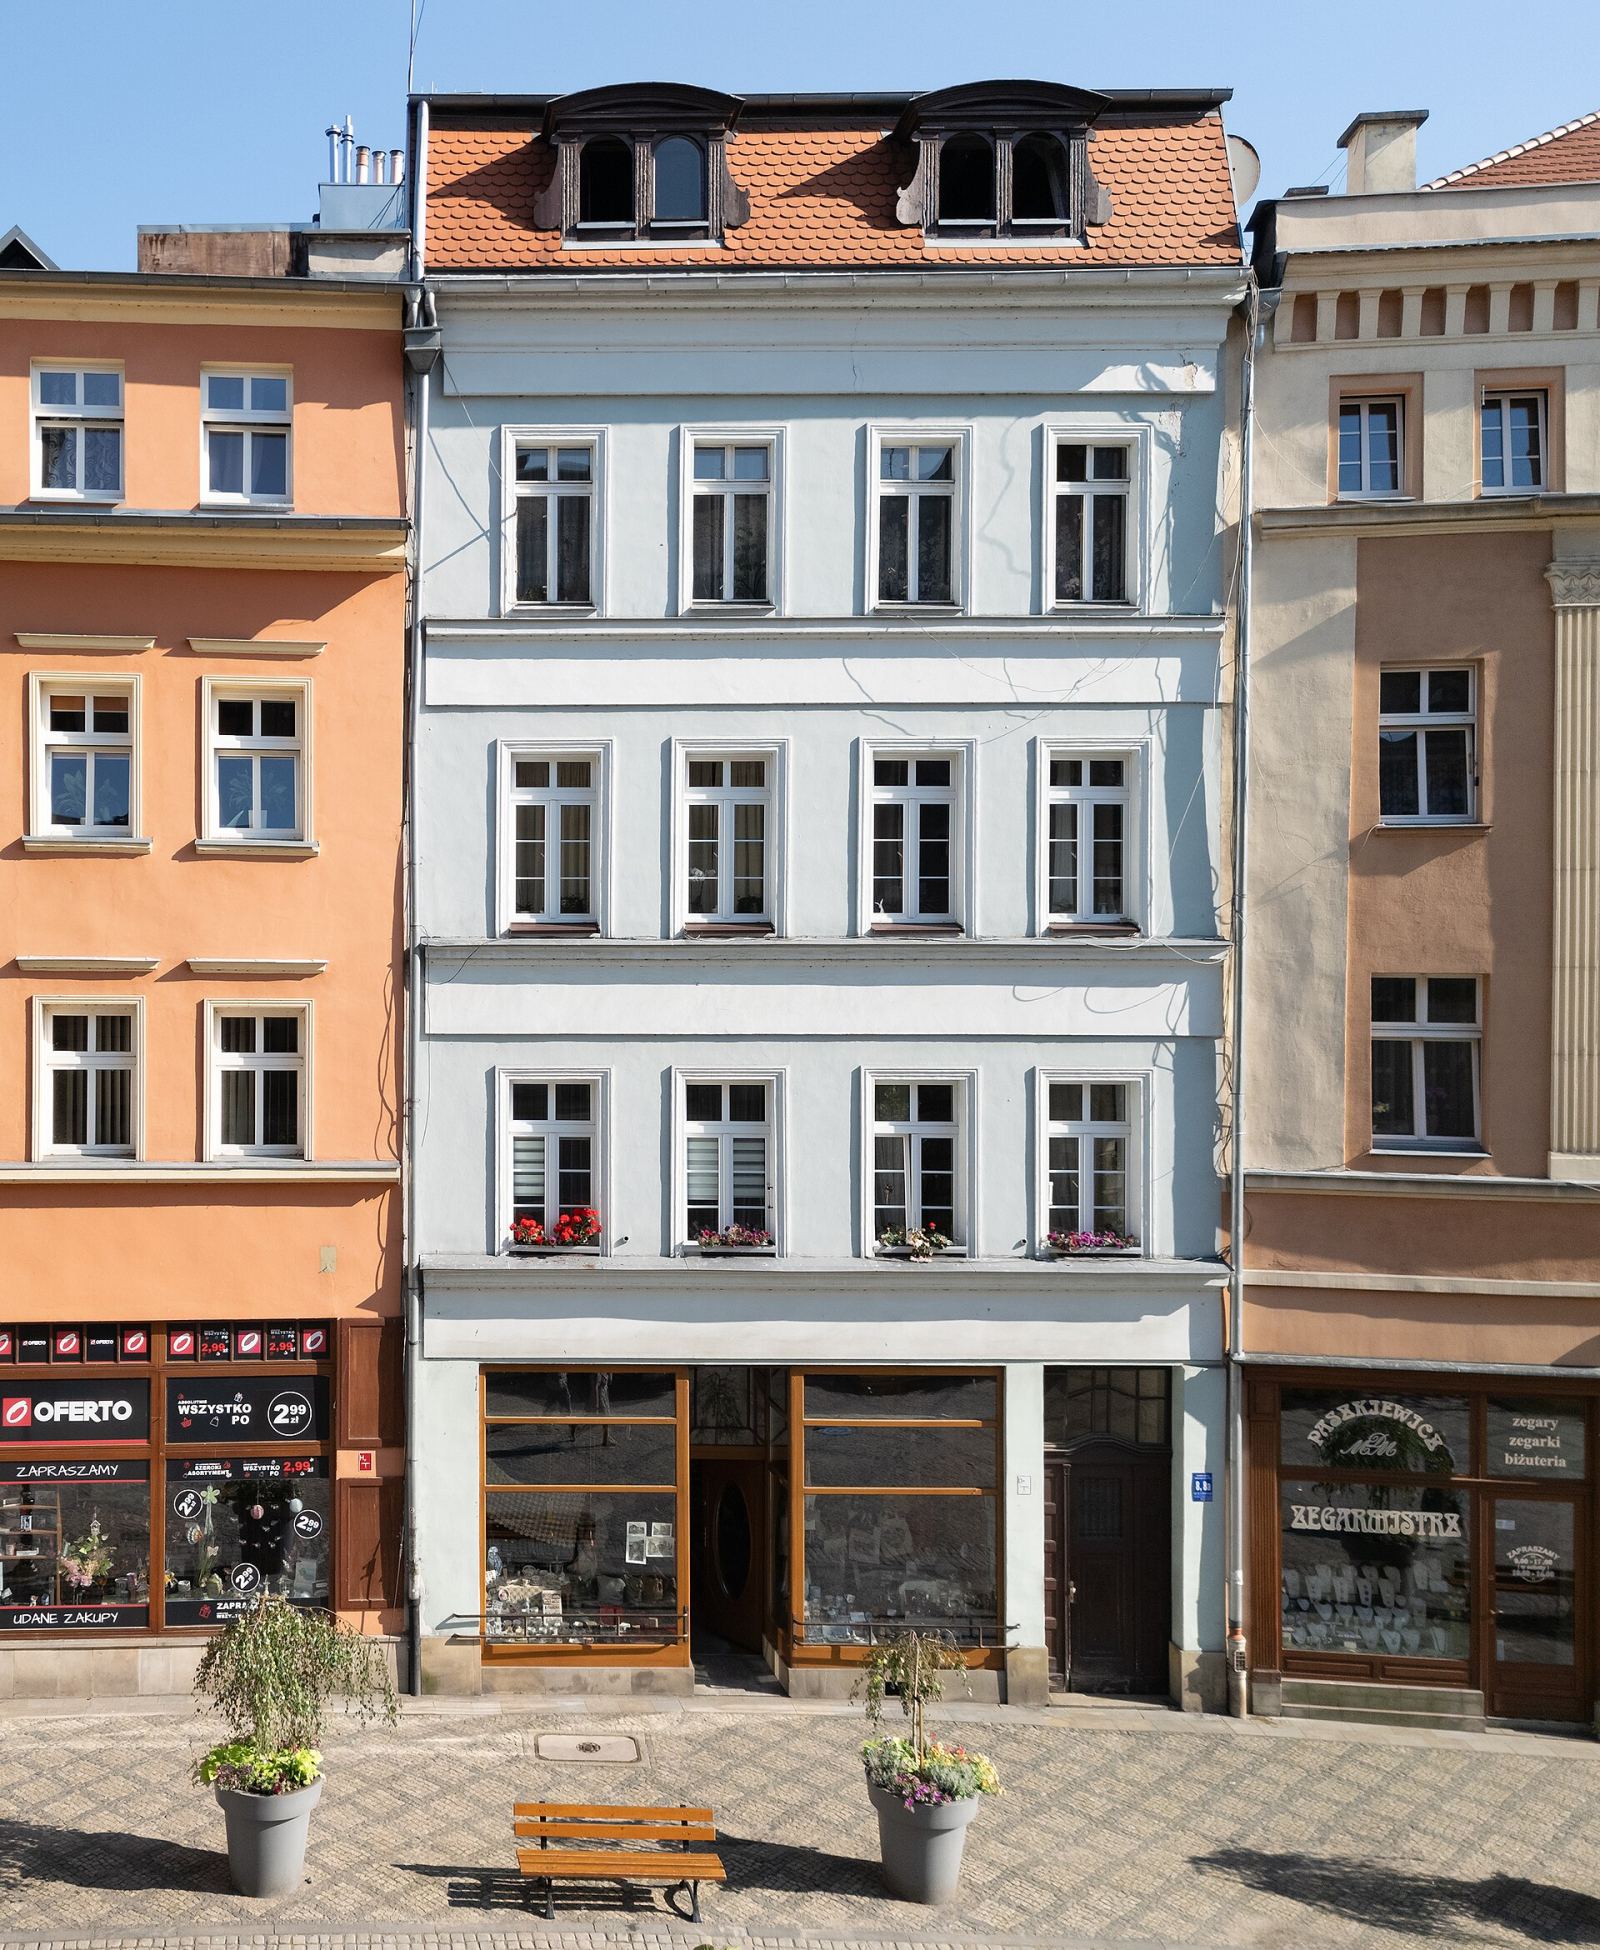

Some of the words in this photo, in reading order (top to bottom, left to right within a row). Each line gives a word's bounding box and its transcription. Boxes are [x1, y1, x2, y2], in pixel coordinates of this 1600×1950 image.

[202, 1342, 225, 1353] 2,99
[269, 1341, 293, 1352] 2,99
[34, 1400, 133, 1423] OFERTO
[178, 1403, 252, 1415] WSZYSTKO
[231, 1415, 250, 1425] PO
[290, 1415, 300, 1424] zł
[1307, 1400, 1444, 1452] PASZKIEWICZ
[1512, 1417, 1559, 1431] zegary
[1509, 1436, 1561, 1450] zegarki
[283, 1461, 311, 1473] 2,99
[1504, 1452, 1567, 1468] biżuteria
[16, 1464, 119, 1478] ZAPRASZAMY
[1290, 1504, 1462, 1538] ZEGARMISTRZ
[1506, 1545, 1561, 1560] ZAPRASZAMY
[13, 1613, 59, 1625] UDANE
[63, 1612, 119, 1624] ZAKUPY
